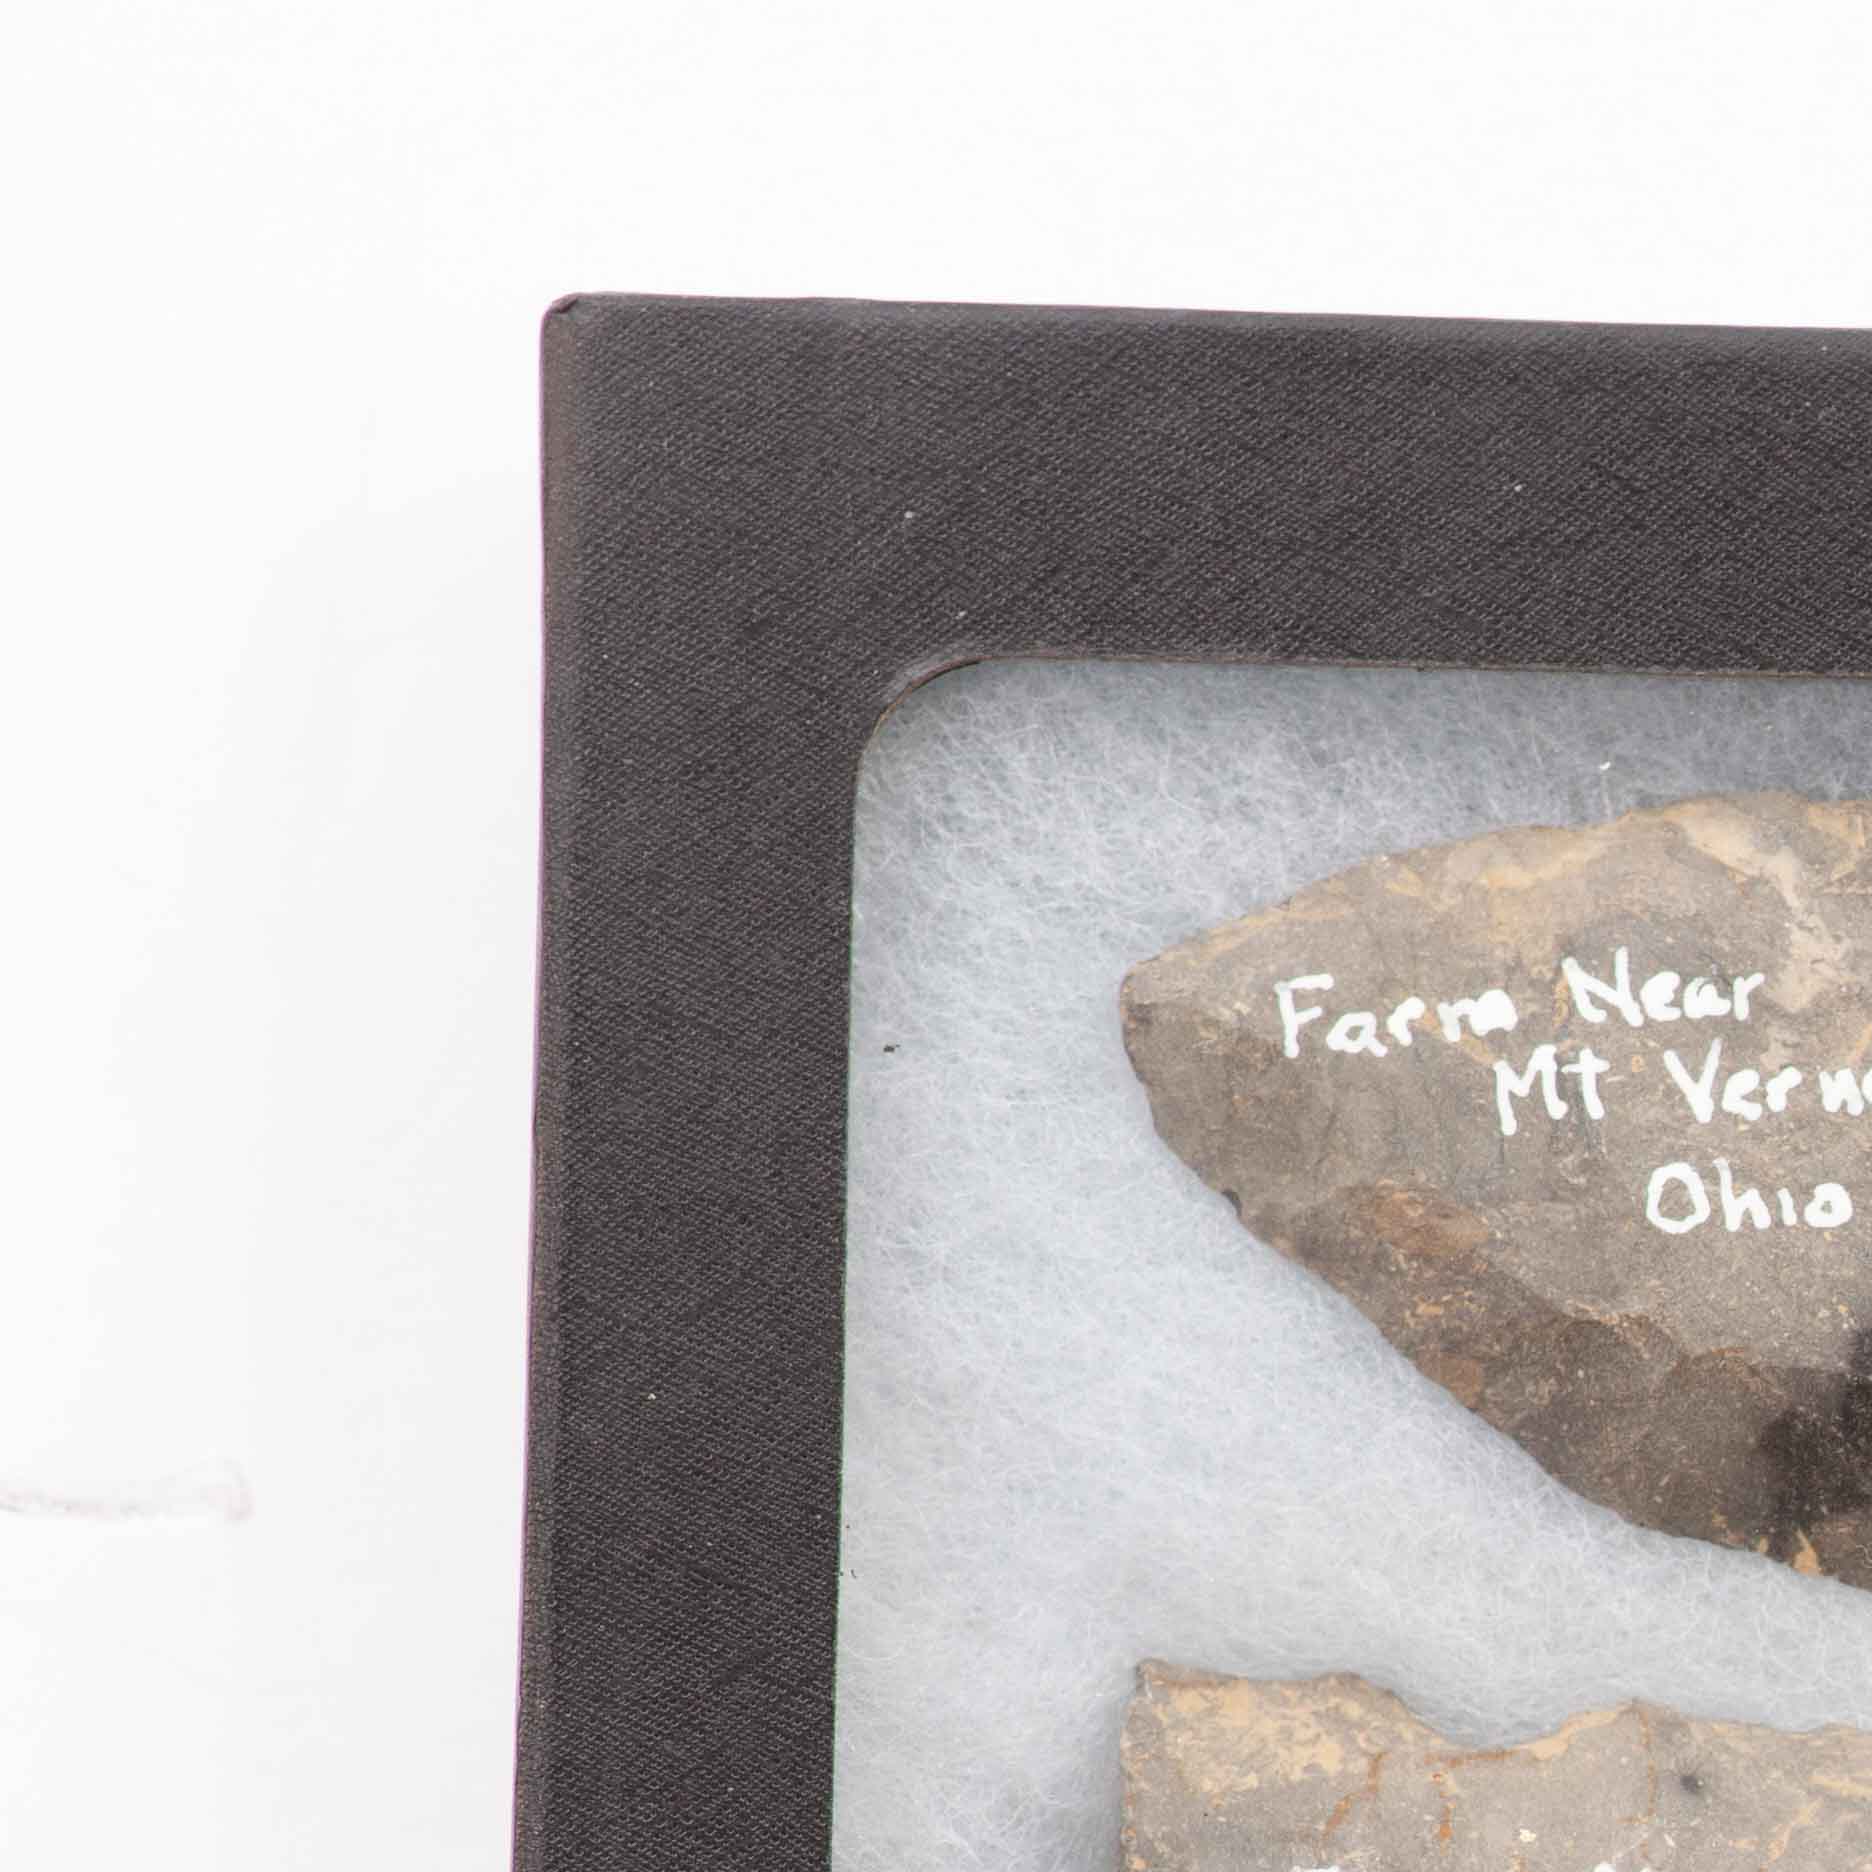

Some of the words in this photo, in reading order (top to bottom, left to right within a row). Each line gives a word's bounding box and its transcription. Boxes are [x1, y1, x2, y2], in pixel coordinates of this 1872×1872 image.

[1274, 973, 1518, 1057] Farm
[1560, 947, 1765, 1027] Near
[1493, 1044, 1610, 1135] Mt
[1645, 1158, 1855, 1234] Ohio
